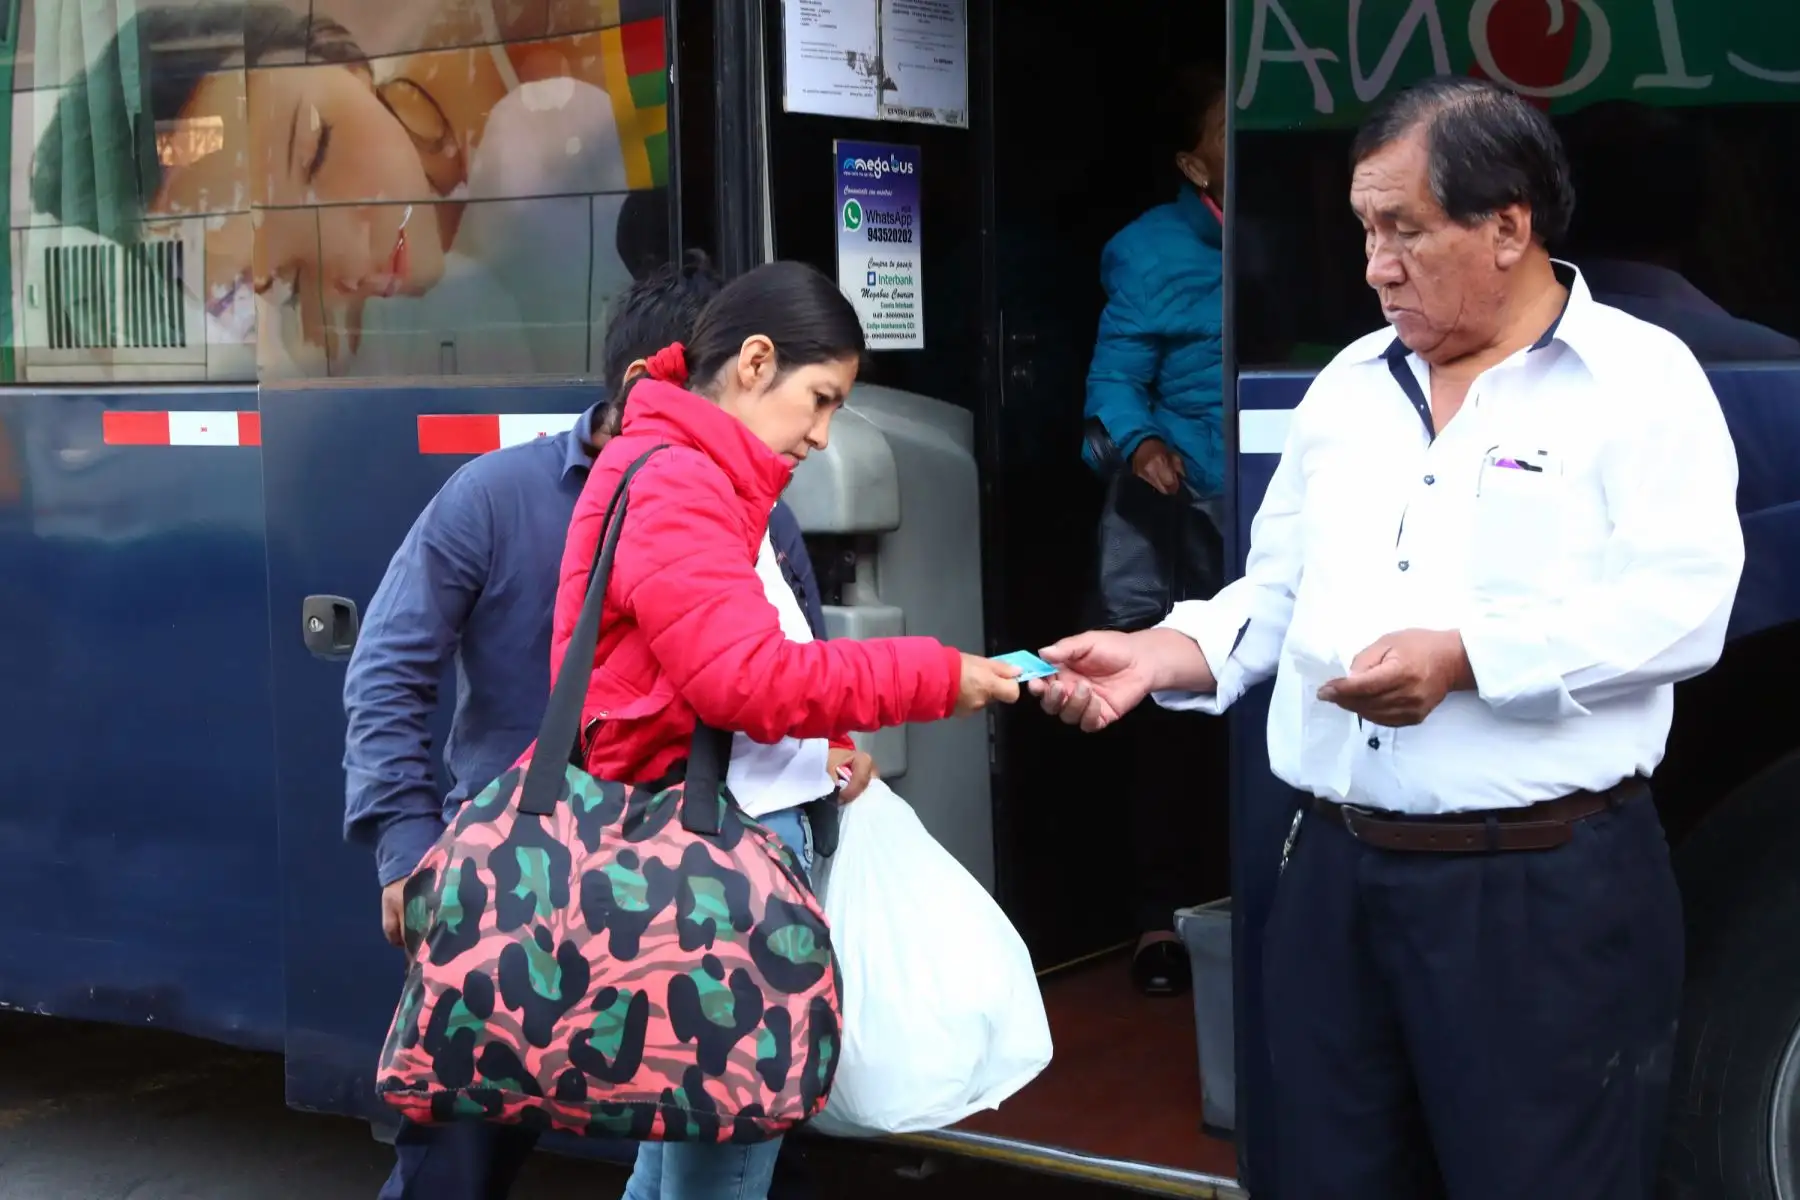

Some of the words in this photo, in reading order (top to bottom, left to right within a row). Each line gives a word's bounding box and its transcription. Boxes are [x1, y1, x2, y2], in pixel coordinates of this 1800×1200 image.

[866, 209, 913, 228] WhatsApp
[867, 228, 913, 243] 943520202
[878, 273, 914, 286] Interbank
[861, 287, 889, 301] Megabus
[891, 288, 914, 300] Courier
